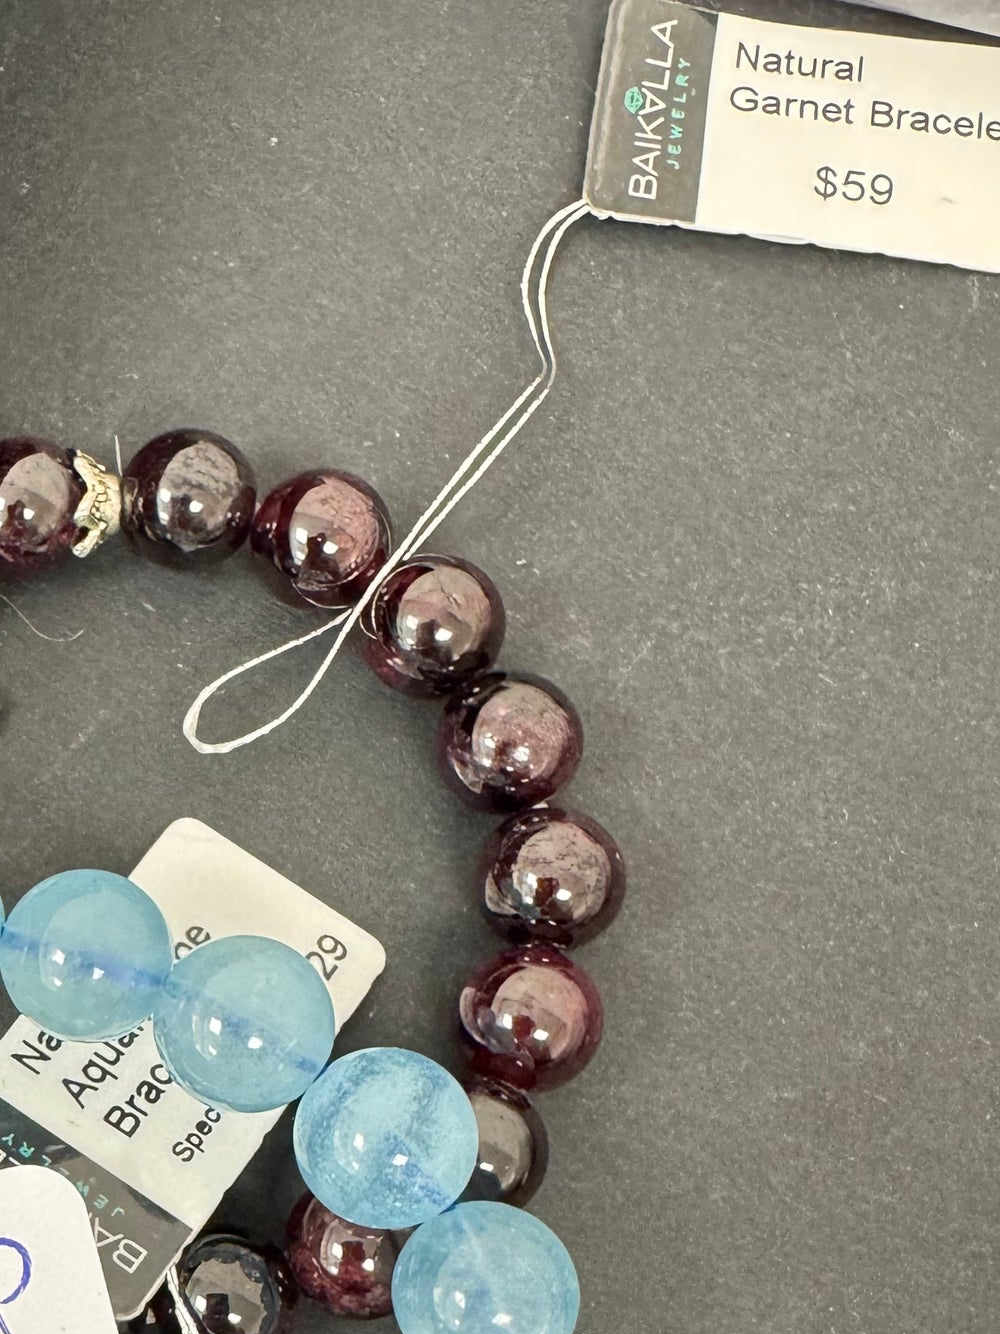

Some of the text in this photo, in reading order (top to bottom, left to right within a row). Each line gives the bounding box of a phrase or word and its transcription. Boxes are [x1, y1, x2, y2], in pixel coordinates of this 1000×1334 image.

[735, 41, 865, 83] Natural
[665, 56, 692, 171] JEWELRY
[729, 85, 1000, 141] Garnet Bracele
[813, 165, 895, 206] $59
[171, 934, 348, 1163] Spec 29
[102, 1063, 174, 1139] Brac
